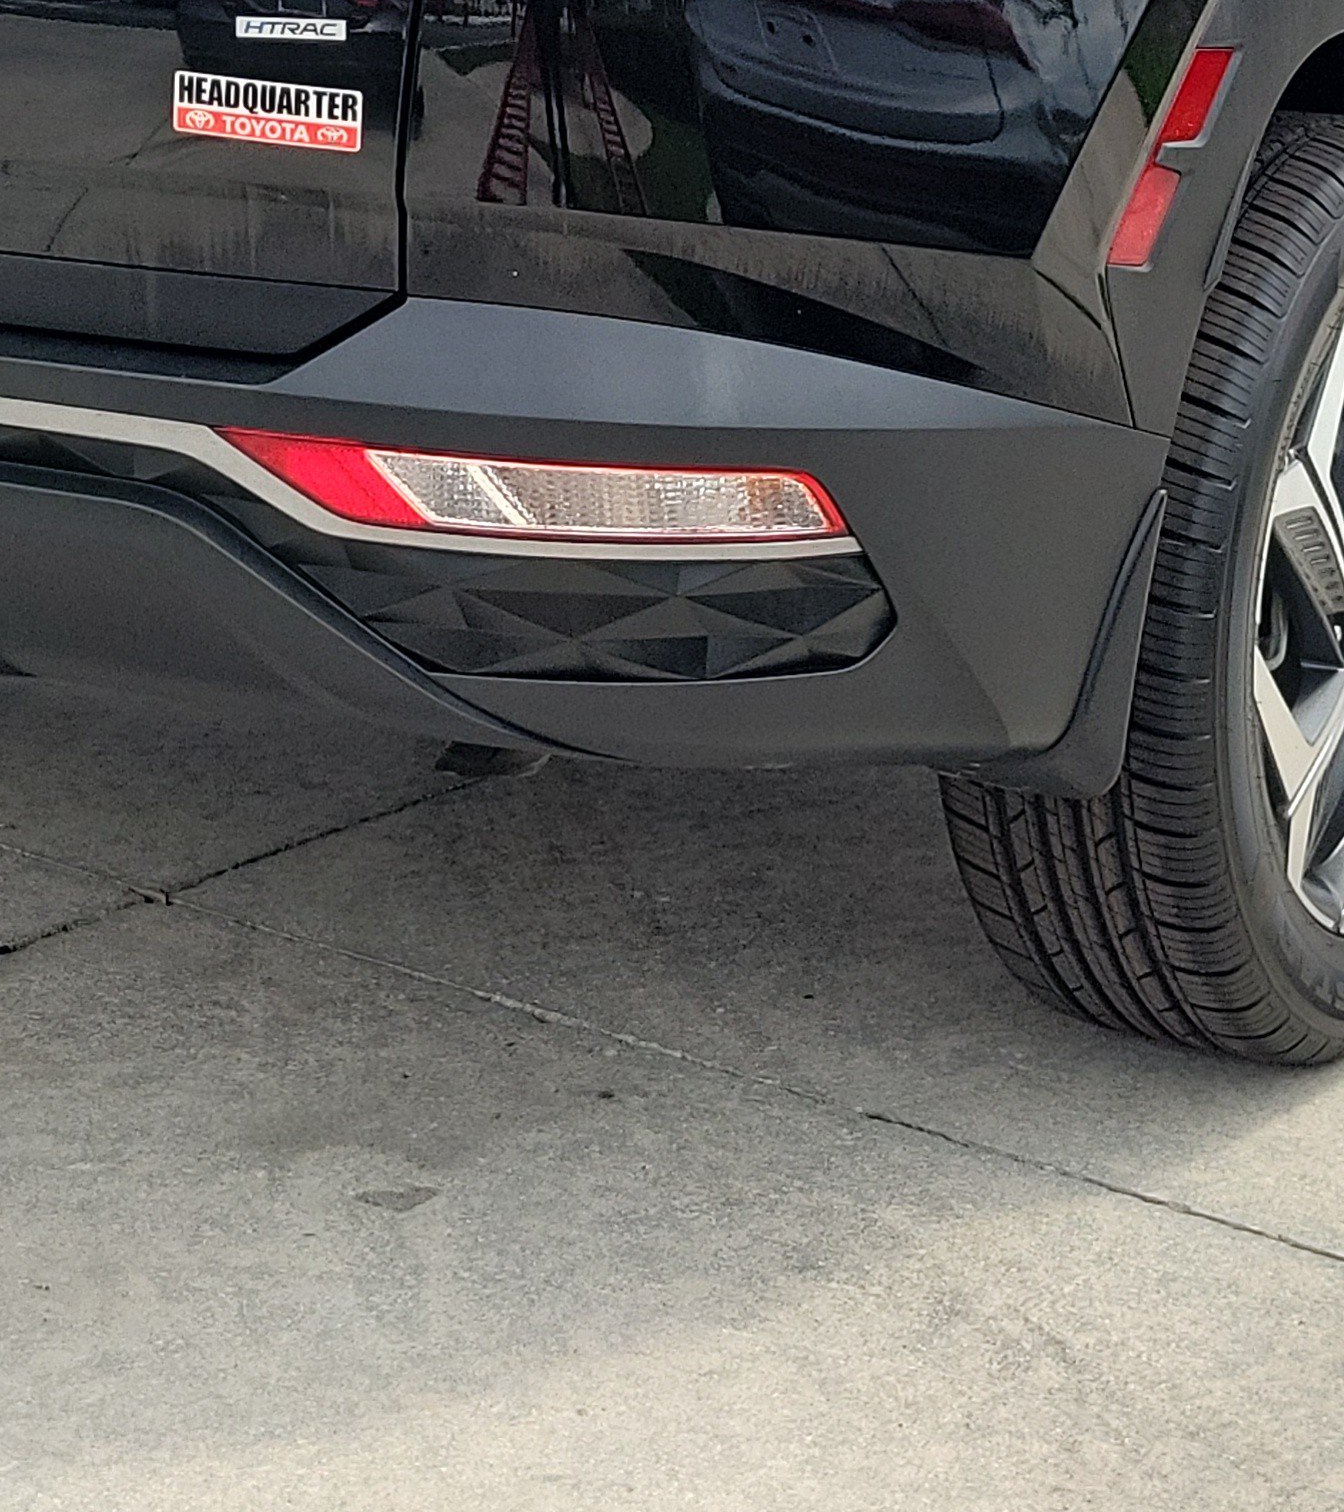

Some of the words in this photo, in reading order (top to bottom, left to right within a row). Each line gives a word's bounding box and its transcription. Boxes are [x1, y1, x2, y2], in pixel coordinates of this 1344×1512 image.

[244, 21, 338, 36] HTRAC
[178, 74, 357, 122] HEADQUARTER
[222, 116, 310, 142] TOYOTA
